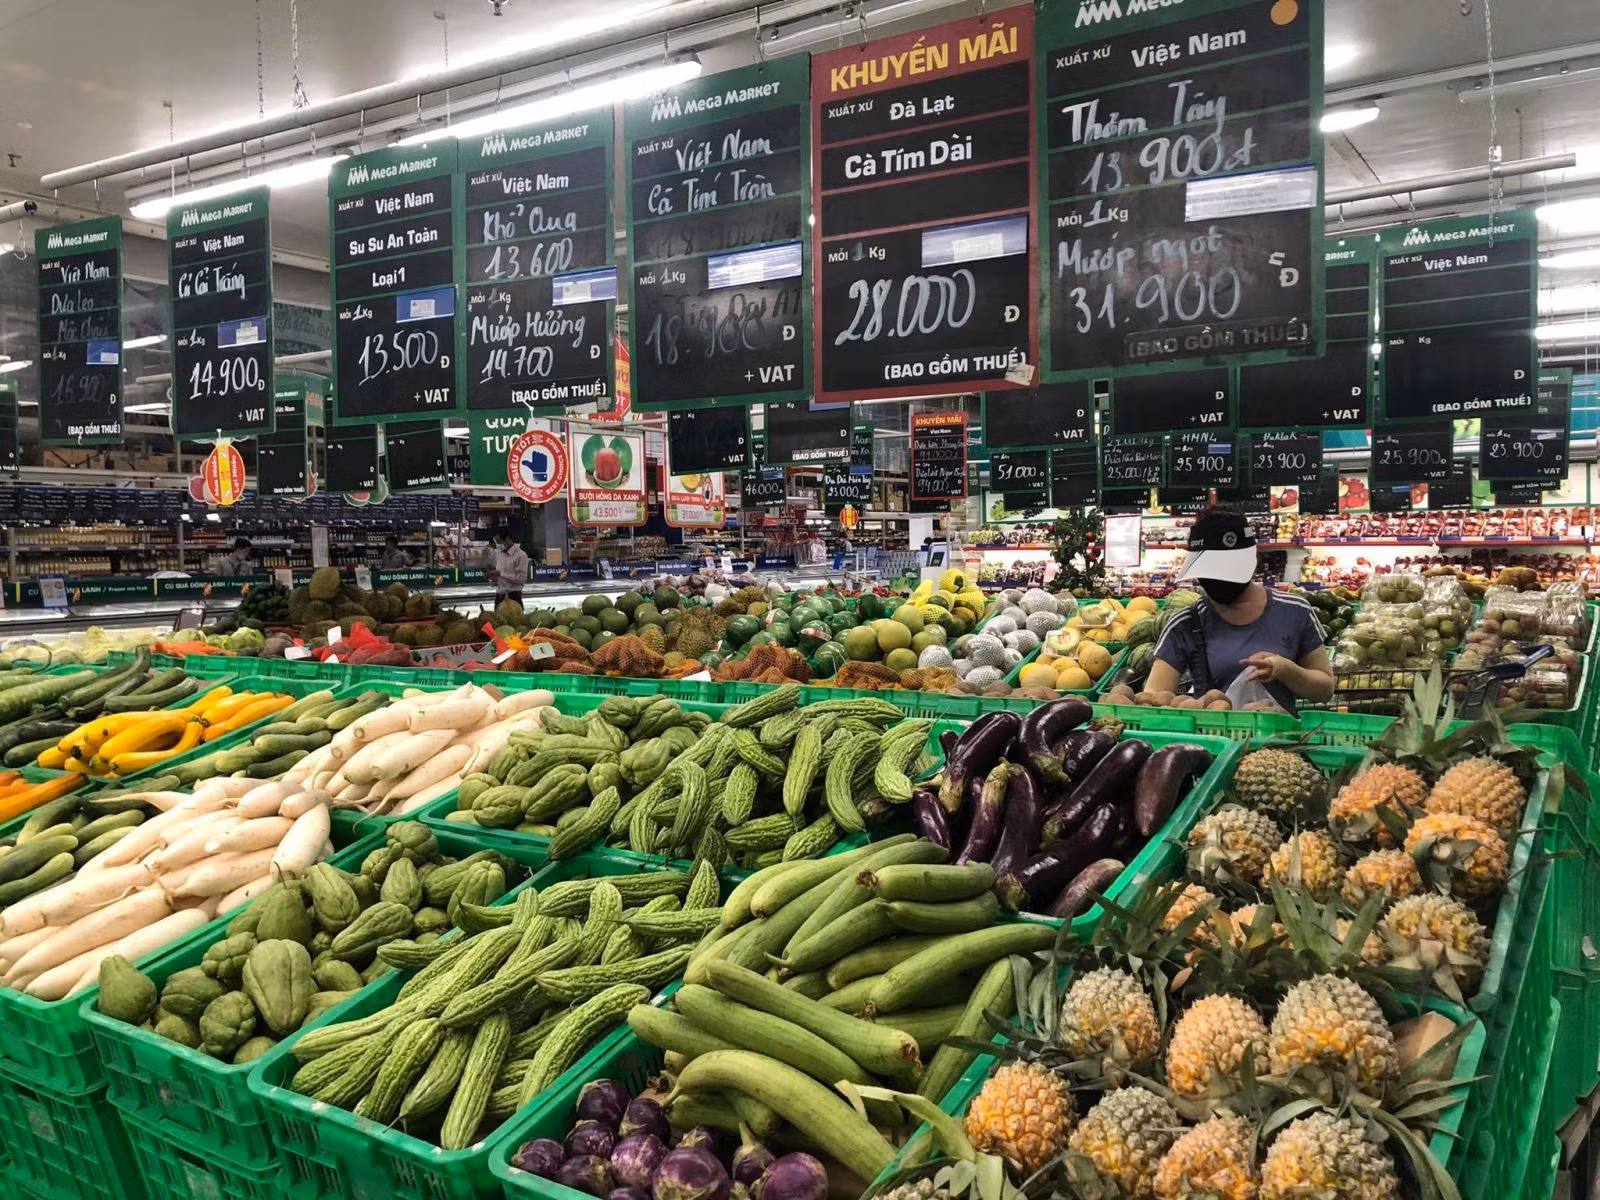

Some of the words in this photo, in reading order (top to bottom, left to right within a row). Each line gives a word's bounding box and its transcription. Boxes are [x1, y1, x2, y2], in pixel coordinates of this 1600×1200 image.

[831, 36, 949, 92] KHUYẾN
[959, 23, 1018, 65] MÃI
[1056, 52, 1091, 69] XUẤT
[1093, 45, 1111, 59] XỨ
[1131, 42, 1181, 68] Việt
[1188, 29, 1246, 56] Nam
[828, 103, 855, 119] XUẤT
[858, 100, 874, 114] XỨ
[890, 98, 915, 121] Đà
[922, 95, 955, 116] Lạt
[637, 140, 660, 156] XUẤT
[661, 137, 674, 151] XỨ
[722, 128, 774, 161] Nam
[845, 154, 877, 180] Cà
[881, 149, 925, 174] Tím
[930, 133, 972, 165] Dài
[503, 176, 533, 194] Việt
[536, 173, 569, 190] Nam
[375, 198, 401, 214] Việt
[404, 192, 434, 208] Nam
[1083, 199, 1108, 228] 1
[1108, 207, 1129, 223] Kg
[203, 239, 221, 252] Việt
[224, 234, 244, 248] Nam
[350, 241, 365, 256] Su
[368, 237, 384, 252] Su
[387, 233, 404, 249] An
[407, 227, 438, 246] Toàn
[484, 238, 573, 280] 13.600
[868, 246, 887, 261] Kg
[1424, 257, 1453, 271] Việt
[1456, 253, 1488, 267] Nam
[85, 260, 110, 279] Nam
[660, 267, 672, 285] 1
[672, 270, 686, 284] Kg
[1279, 267, 1299, 288] Đ
[500, 292, 511, 303] Kg
[835, 268, 976, 346] 28.000
[1070, 267, 1242, 334] 31.900
[352, 304, 363, 321] 1
[363, 308, 373, 319] Kg
[1004, 305, 1020, 324] Đ
[782, 325, 795, 341] Đ
[1418, 336, 1431, 345] Kg
[358, 329, 438, 386] 13.500
[590, 344, 600, 359] Đ
[440, 355, 450, 369] Đ
[480, 345, 553, 384] 14.700
[884, 358, 925, 381] (BAO
[928, 351, 968, 376] GỒM
[973, 347, 1026, 373] THUẾ)
[189, 357, 258, 400] 14.900
[759, 364, 795, 384] VAT
[1513, 369, 1525, 380] Đ
[424, 388, 450, 403] VAT
[511, 390, 539, 403] (BAO
[541, 382, 568, 400] GỒM
[571, 378, 606, 397] THUẾ)
[1432, 401, 1461, 413] (BAO
[1464, 396, 1492, 411] GỒM
[1495, 393, 1531, 407] THUẾ)
[246, 408, 265, 421] VAT
[1199, 412, 1224, 423] VAT
[1333, 409, 1360, 420] VAT
[1062, 428, 1084, 439] VAT
[728, 453, 744, 463] VAT
[622, 493, 639, 501] XANH
